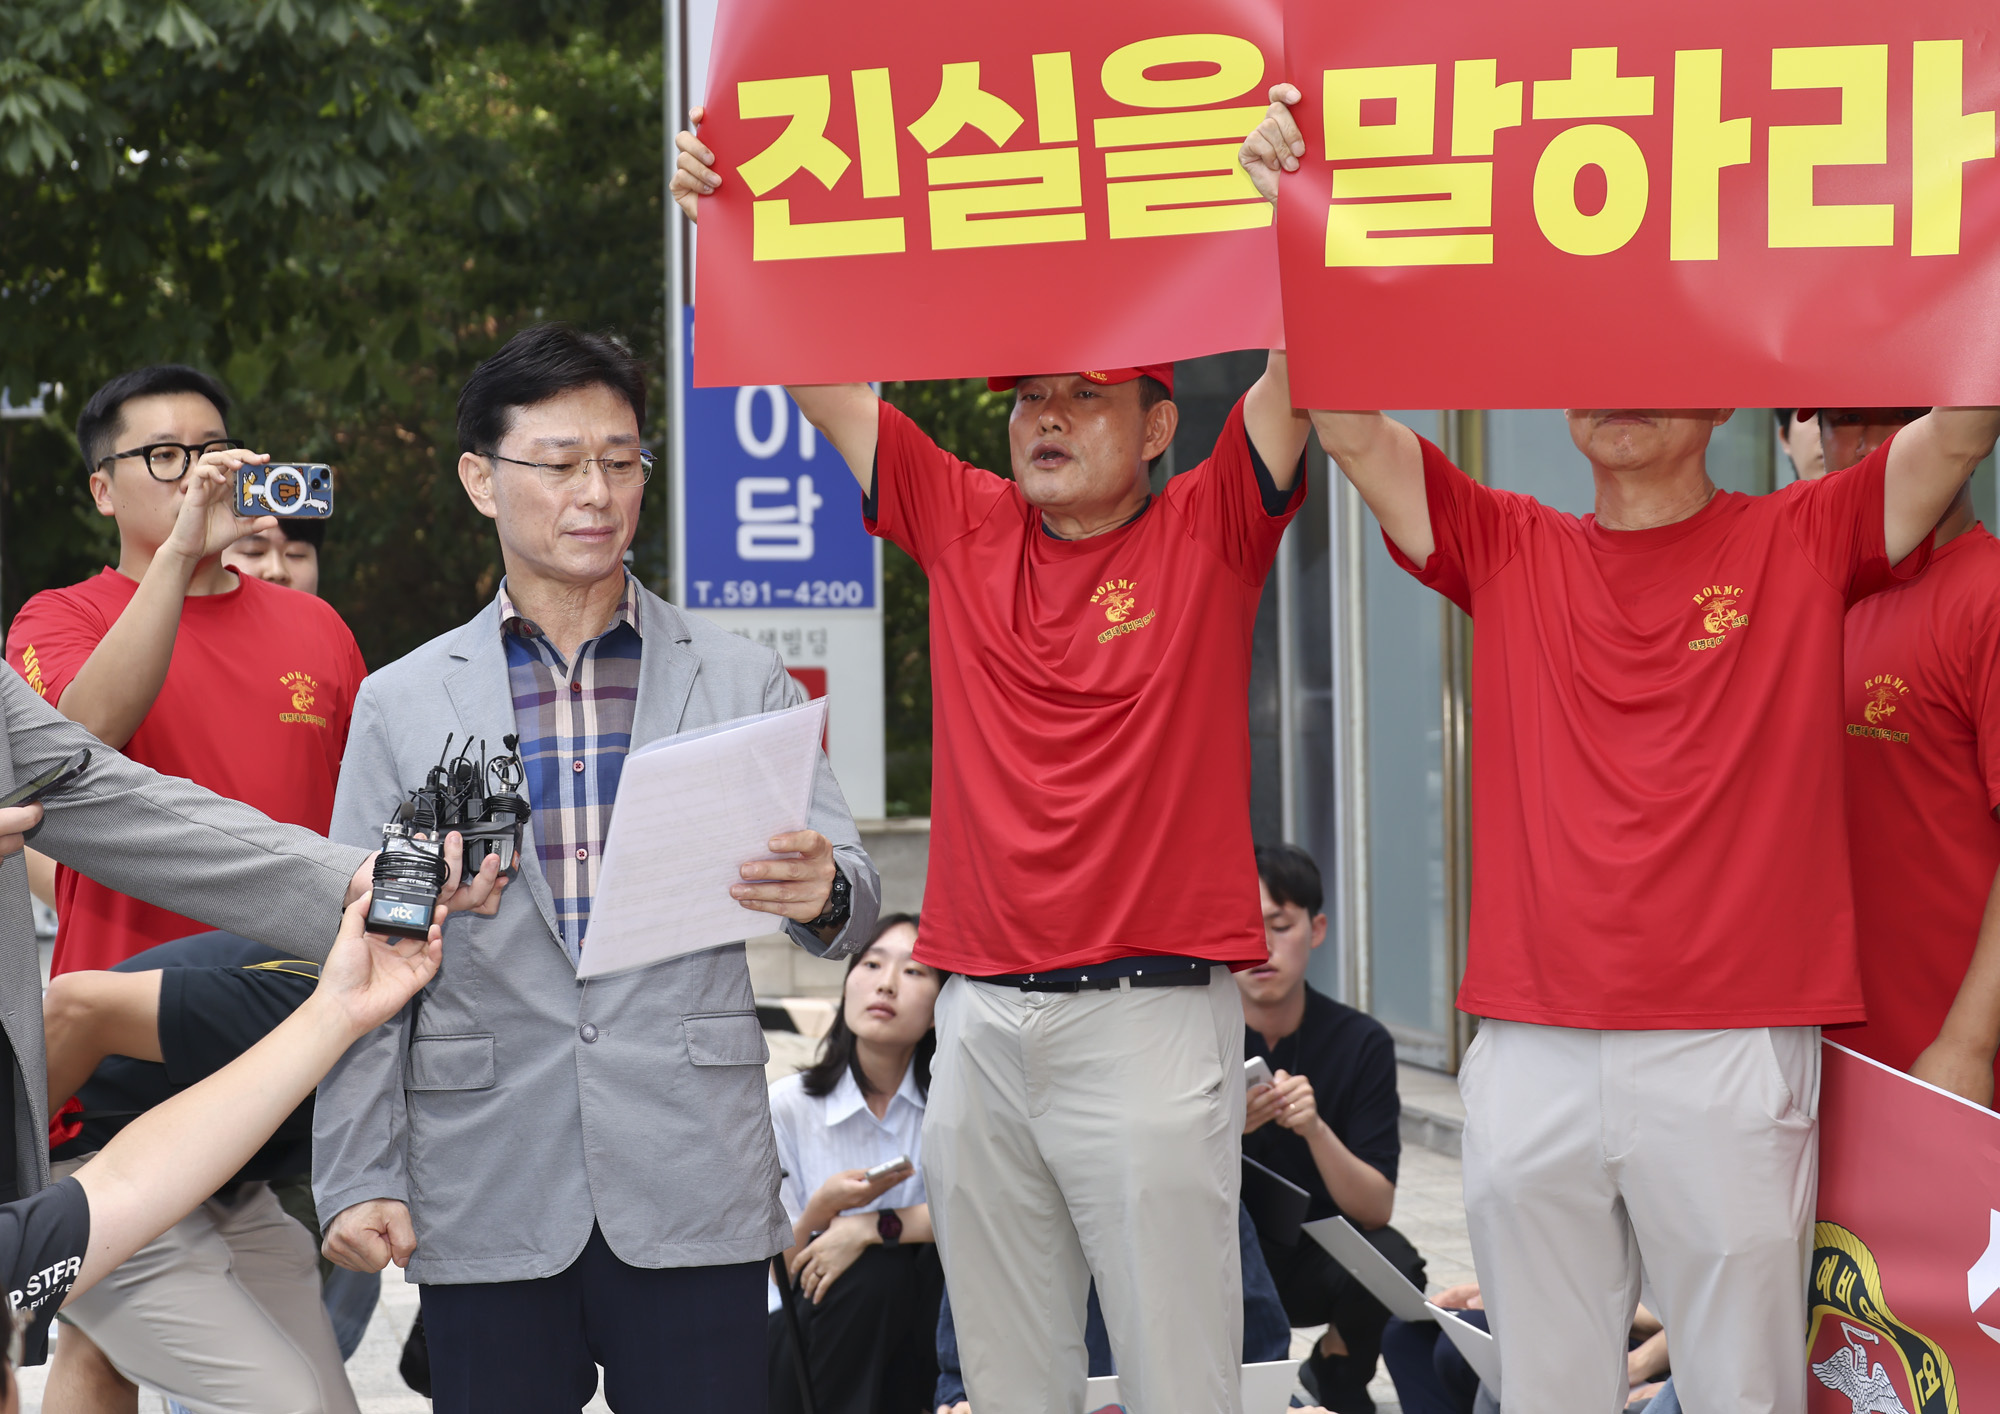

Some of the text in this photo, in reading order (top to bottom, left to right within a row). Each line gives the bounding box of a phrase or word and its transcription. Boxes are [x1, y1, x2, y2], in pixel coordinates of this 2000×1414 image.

[736, 33, 1274, 262] 진실을
[1322, 39, 1996, 268] 말하라
[693, 580, 864, 608] T.591-4200
[1090, 579, 1138, 604] ROKMC
[1692, 584, 1744, 606] ROKMC
[1097, 625, 1121, 644] 해병대
[1120, 617, 1144, 633] 예비역
[279, 671, 318, 689] ROKMC
[1864, 674, 1910, 696] ROKMC
[1816, 1255, 1897, 1339] 예비역
